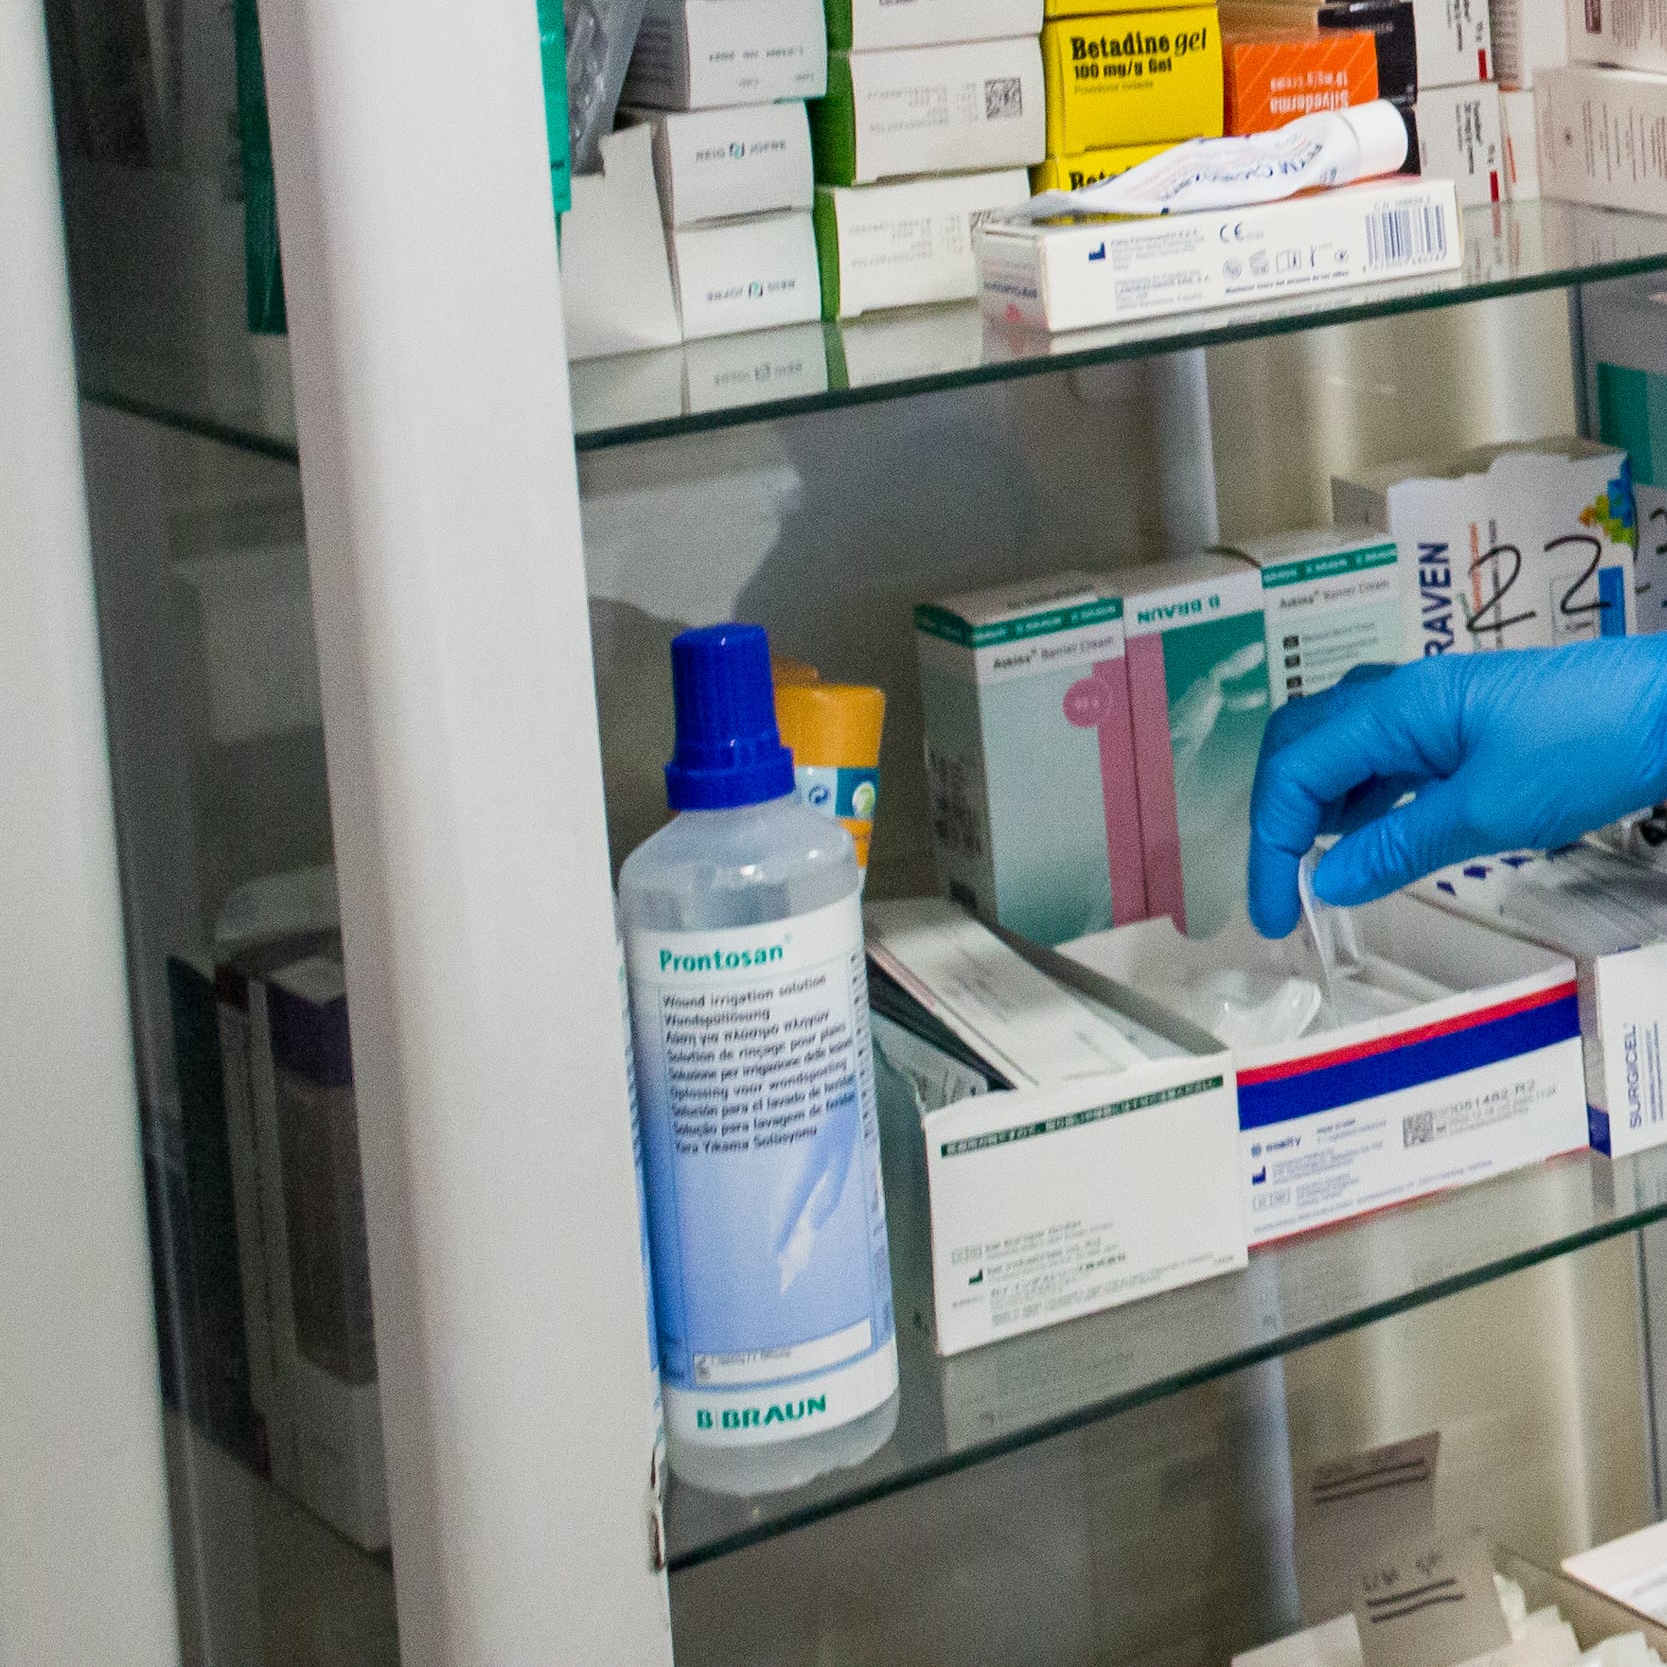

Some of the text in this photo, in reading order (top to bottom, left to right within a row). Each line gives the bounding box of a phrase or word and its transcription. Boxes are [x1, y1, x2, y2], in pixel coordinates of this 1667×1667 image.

[1071, 27, 1208, 60] Betadine gel
[659, 944, 783, 973] Prontosan
[711, 987, 774, 1007] irrigation
[696, 1394, 828, 1430] B BRAUN
